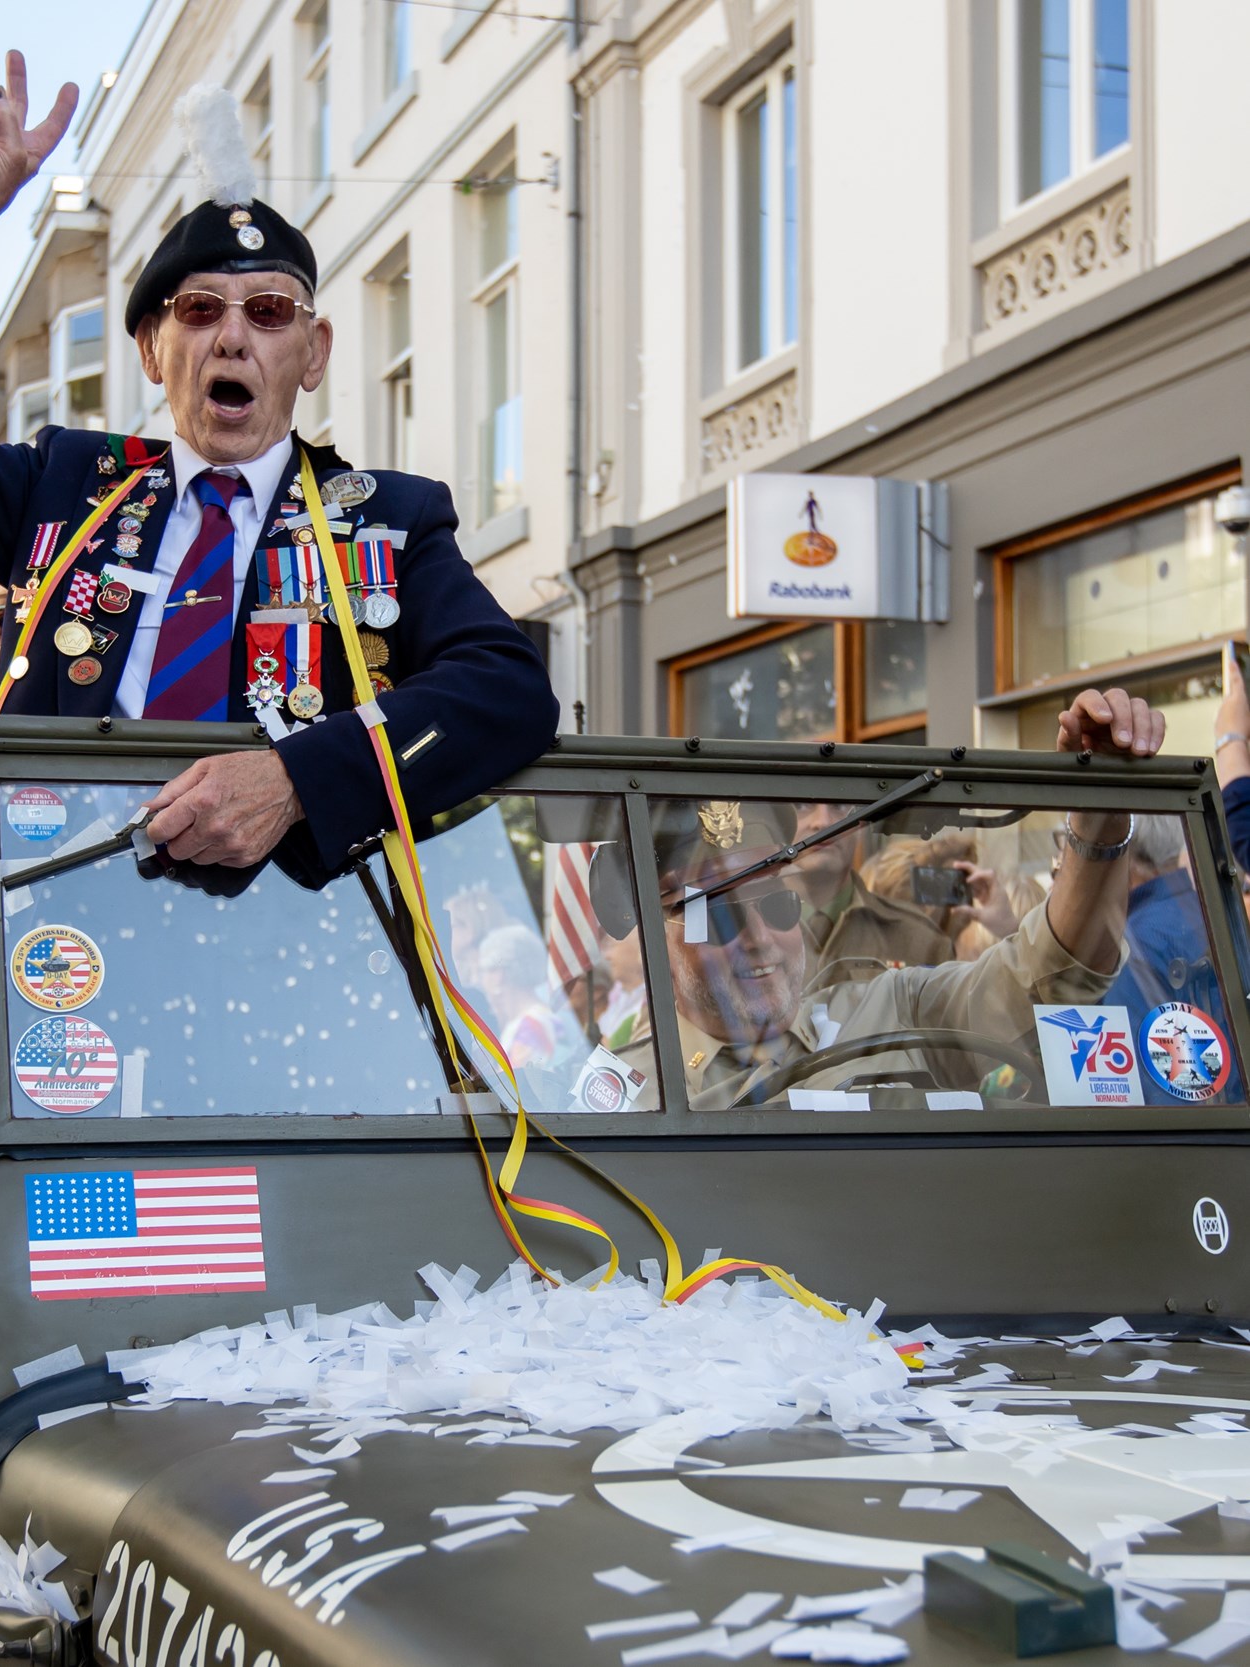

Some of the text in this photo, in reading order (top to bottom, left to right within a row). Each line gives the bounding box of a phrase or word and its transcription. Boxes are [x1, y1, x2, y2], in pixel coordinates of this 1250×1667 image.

[768, 580, 853, 600] Rabobank
[24, 929, 69, 948] ANNIVERSARY
[69, 931, 97, 961] OVERLORD
[23, 984, 38, 1000] GREEN
[37, 995, 54, 1006] CAMP
[65, 992, 87, 1006] OMAHA
[85, 975, 99, 995] BEACH
[1158, 1002, 1194, 1014] D-DAY
[41, 1020, 91, 1031] 1944
[41, 1031, 91, 1042] 2014
[1070, 1031, 1134, 1075] 75
[34, 1079, 100, 1090] Anniversaire
[593, 1079, 618, 1099] LUCKY
[1090, 1083, 1131, 1094] LIBÉRATION
[1167, 1085, 1217, 1100] NORMANDY
[587, 1087, 615, 1109] STRIKE
[1095, 1094, 1128, 1103] NORMANDIE
[227, 1491, 427, 1626] U.S.A.
[98, 1540, 281, 1667] 2074
